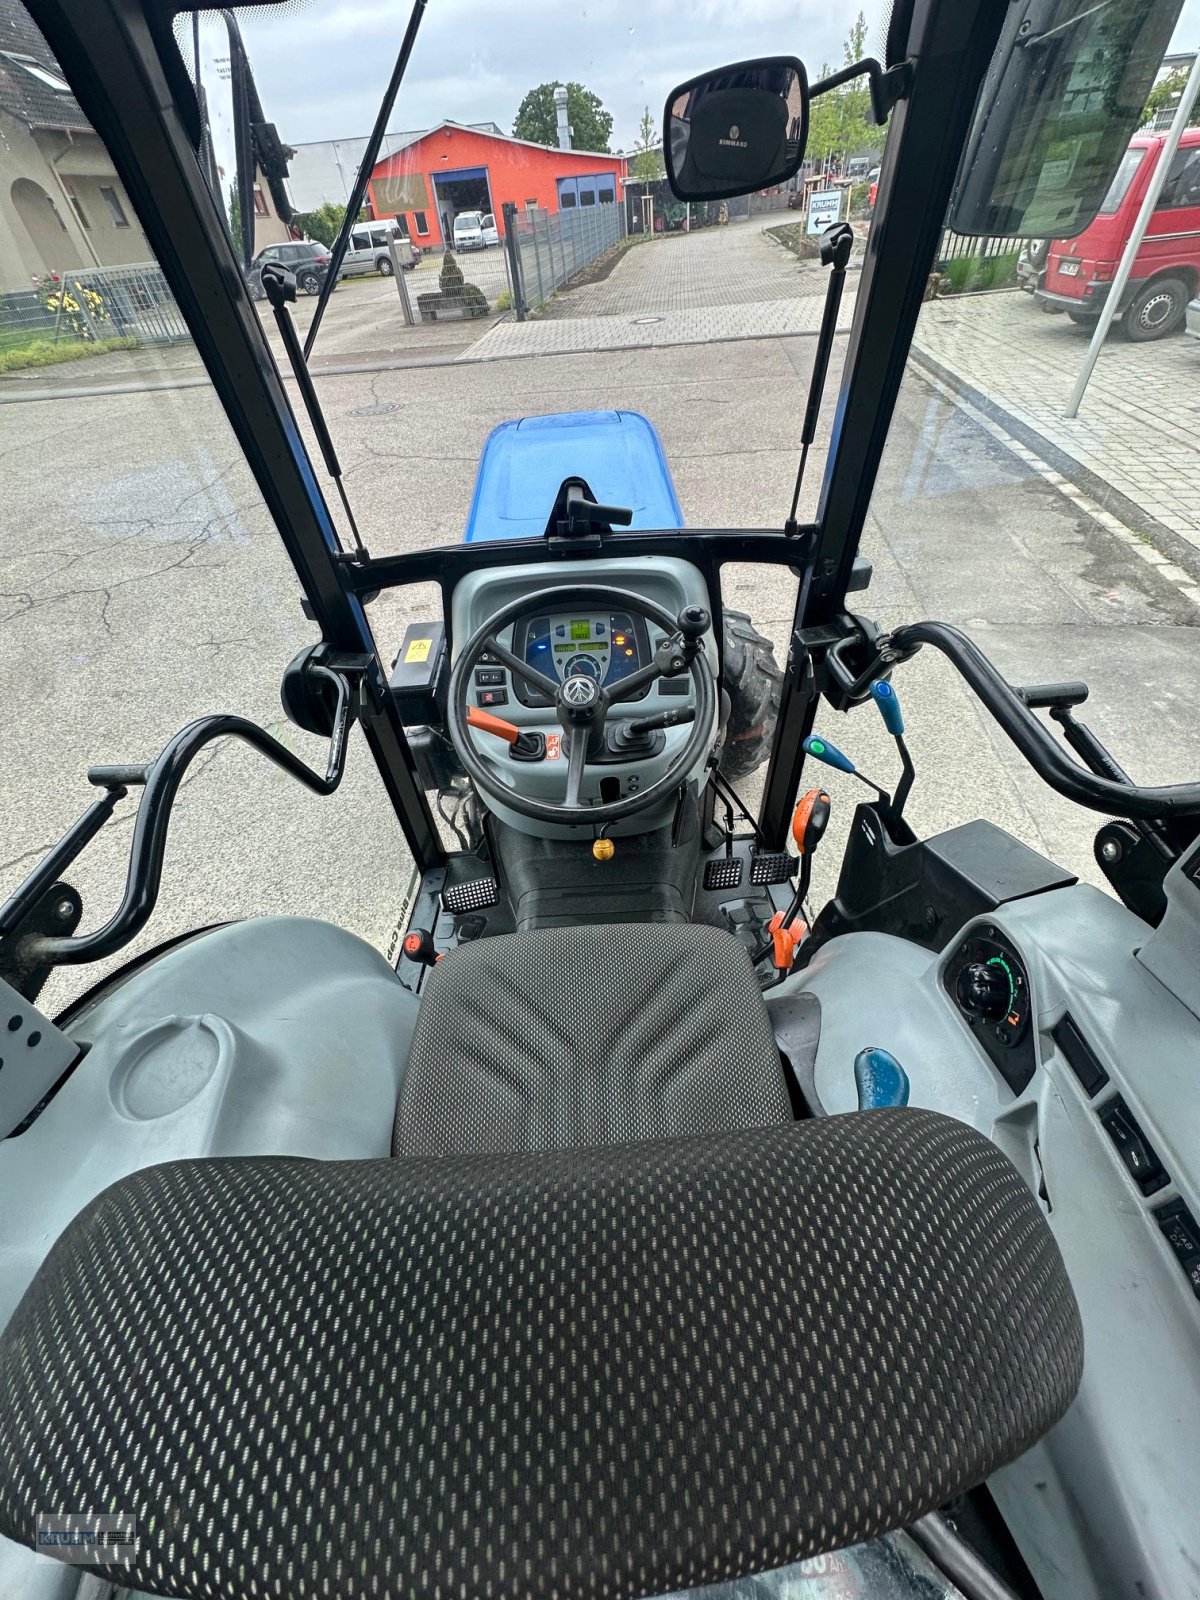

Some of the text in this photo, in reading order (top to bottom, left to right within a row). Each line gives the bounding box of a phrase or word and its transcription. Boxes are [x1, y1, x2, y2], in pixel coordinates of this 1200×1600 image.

[811, 198, 838, 208] KRUMM
[1169, 1234, 1183, 1248] DX
[1173, 1224, 1194, 1250] STAB
